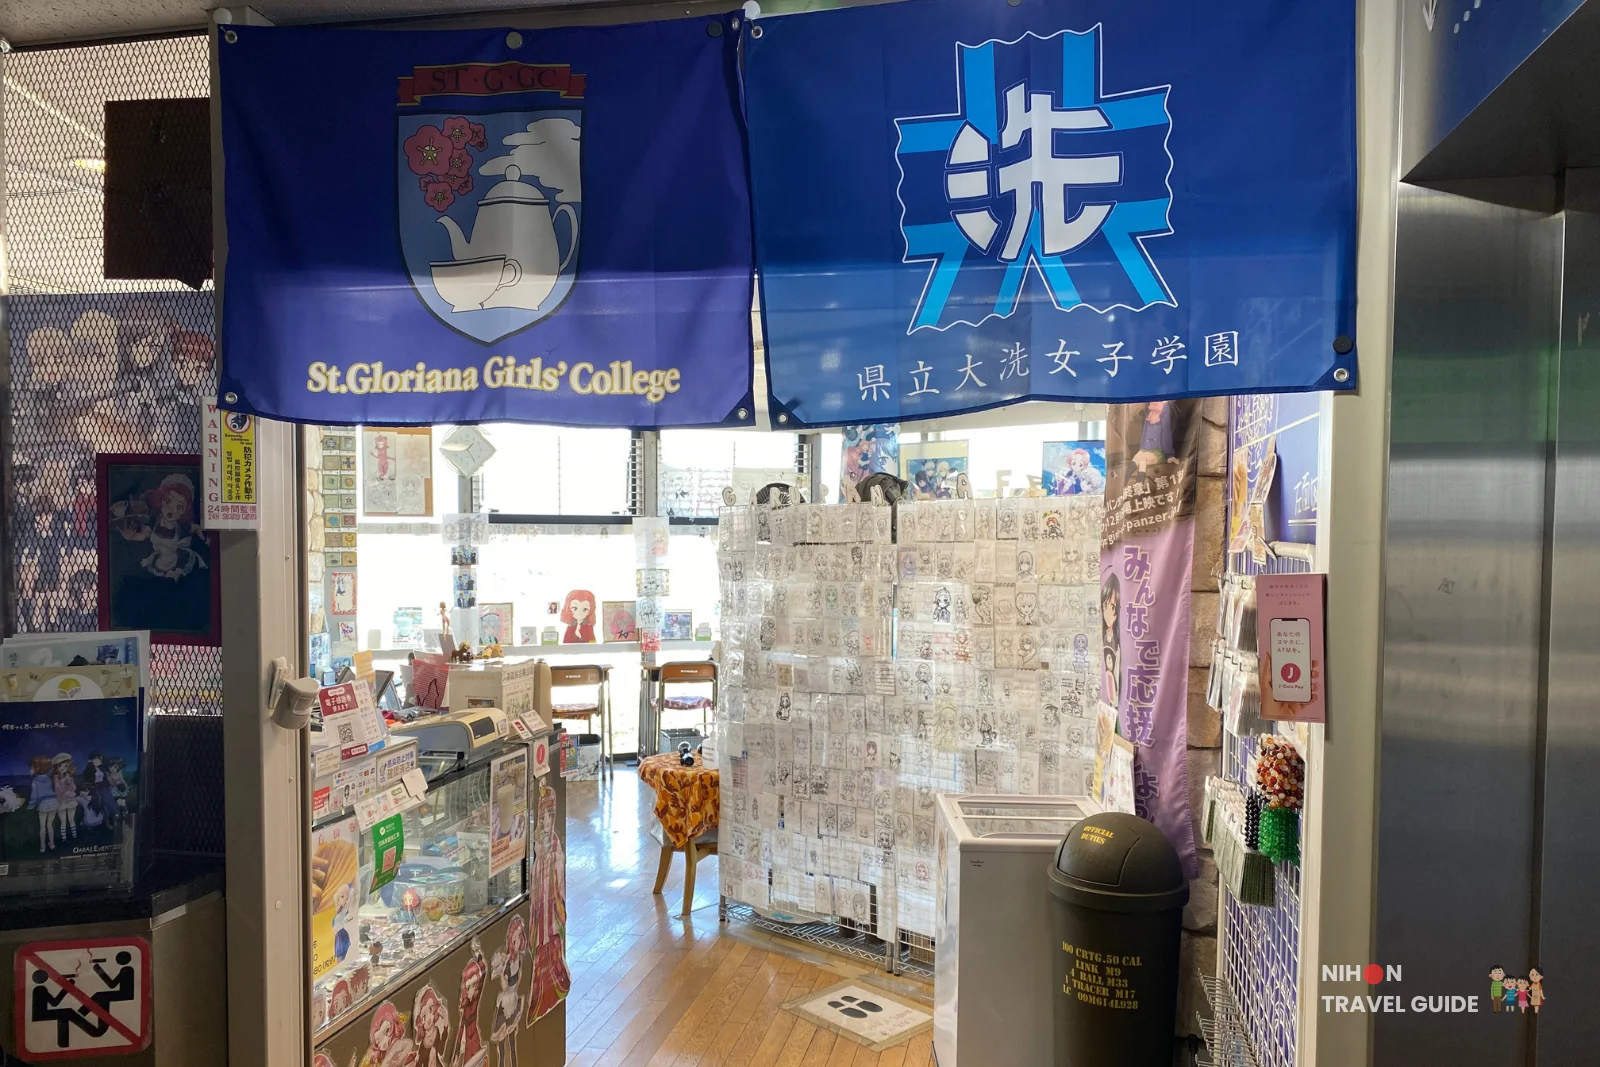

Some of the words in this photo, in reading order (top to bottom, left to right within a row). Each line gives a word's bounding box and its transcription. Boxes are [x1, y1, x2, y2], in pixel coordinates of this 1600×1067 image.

[947, 82, 1121, 260] 洗
[857, 331, 1239, 402] 県立大洗女子学園
[569, 360, 681, 402] College
[207, 404, 219, 502] WARNING
[243, 446, 253, 501] 防犯カメラ作動中
[207, 504, 257, 514] 24時間監視
[1080, 832, 1107, 845] DUTIES
[1083, 825, 1114, 840] OFFICIAL
[1062, 940, 1074, 954] 100
[1121, 956, 1143, 967] CAL
[1075, 959, 1099, 974] LINK
[1105, 966, 1122, 977] M9
[1079, 972, 1104, 986] BALL
[1106, 977, 1129, 988] M33
[1072, 978, 1109, 997] TRACER
[1115, 988, 1136, 999] M17
